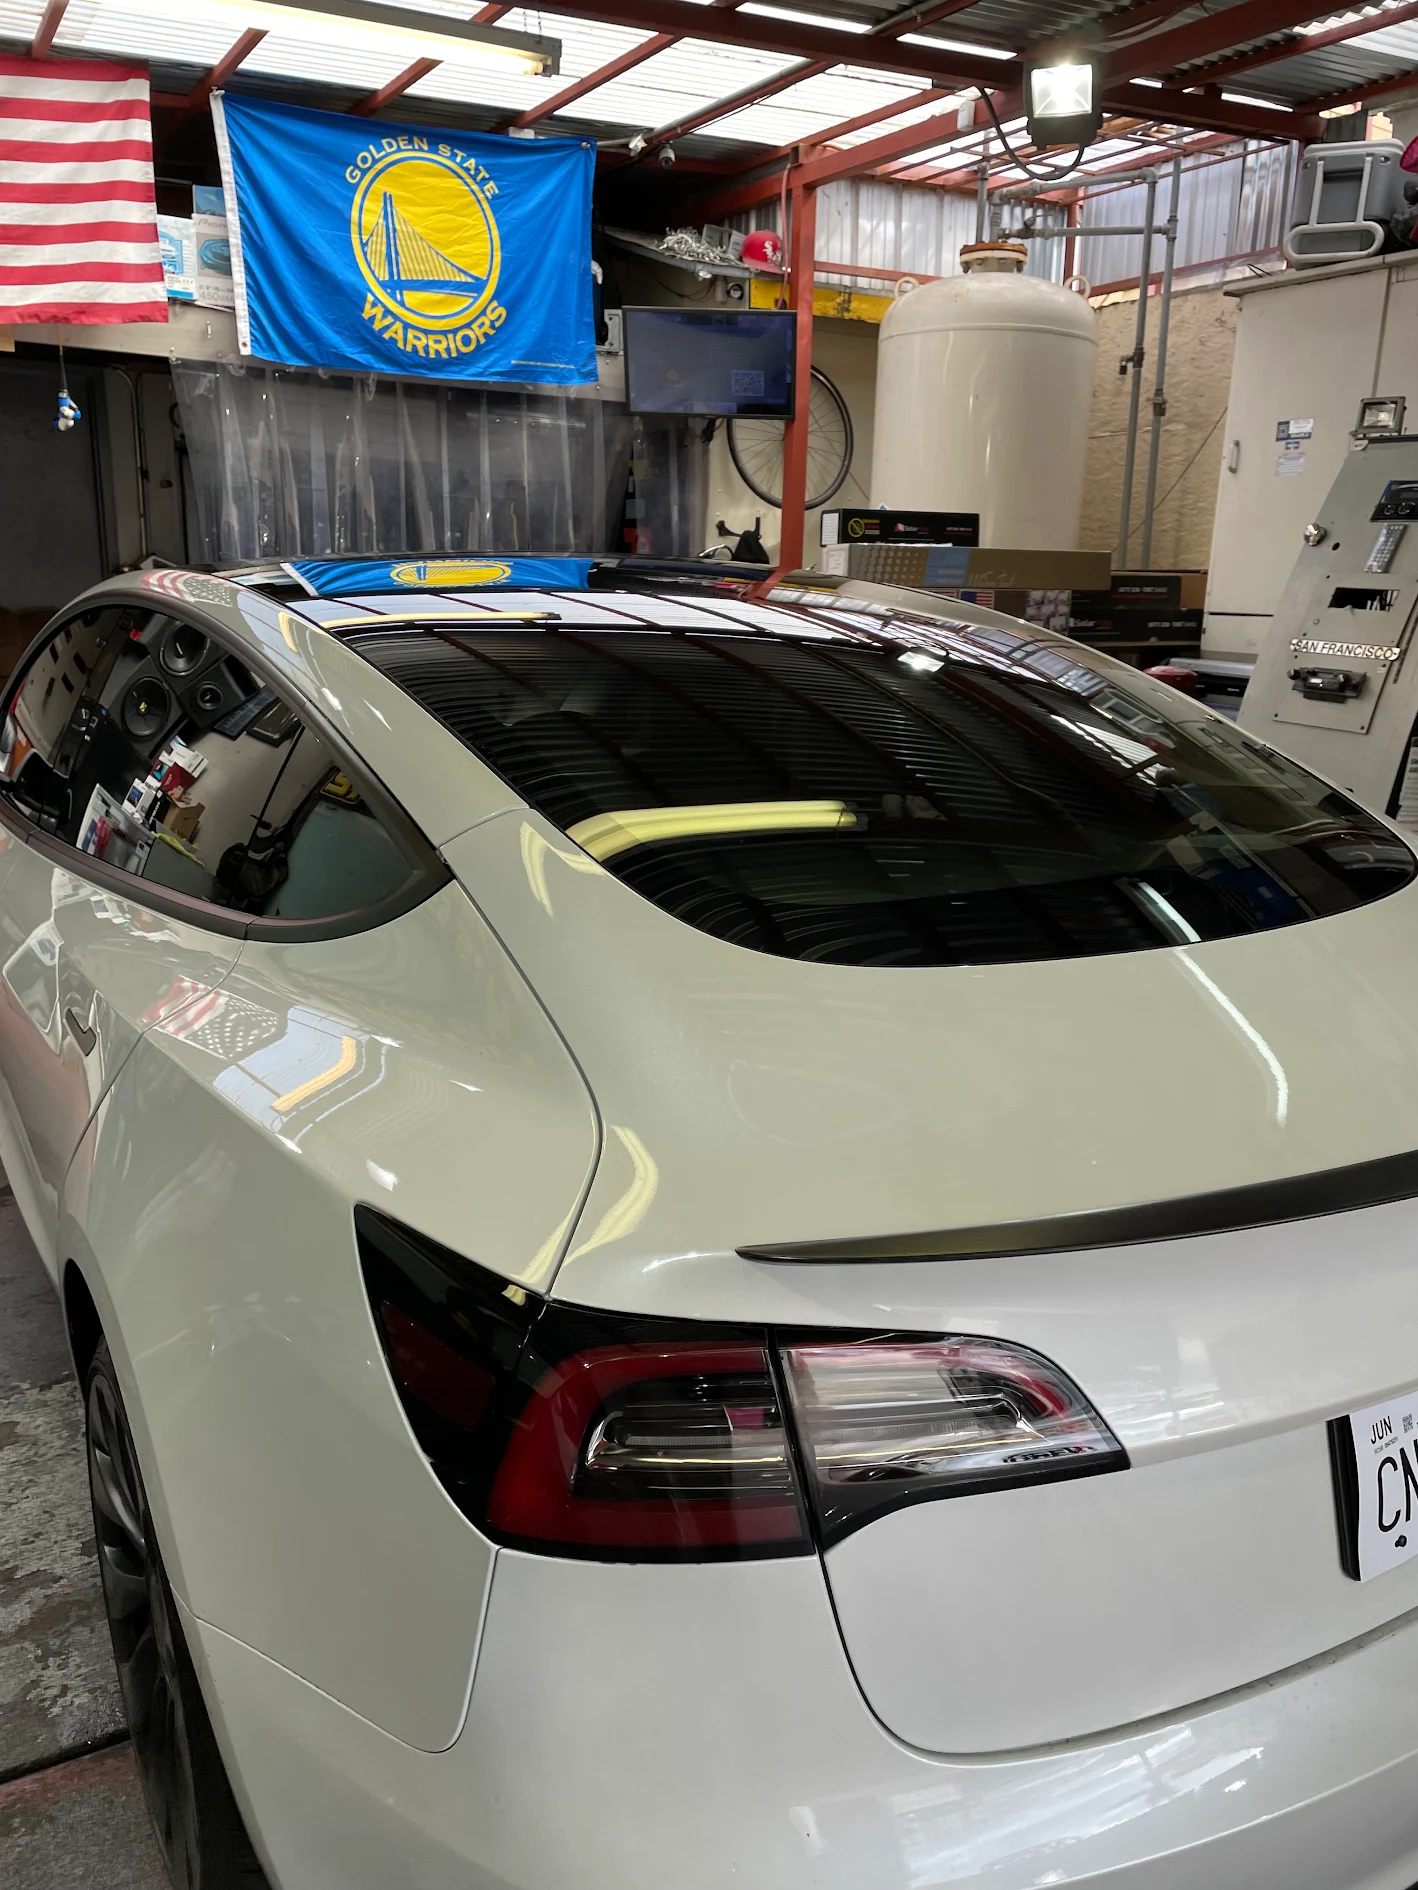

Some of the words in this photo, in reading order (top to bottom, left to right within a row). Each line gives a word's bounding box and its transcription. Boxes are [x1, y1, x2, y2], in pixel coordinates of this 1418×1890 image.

[344, 135, 429, 185] GOLDEN
[437, 143, 500, 200] STATE
[361, 292, 508, 359] WARRIORS
[1295, 640, 1319, 653] SAN
[1320, 642, 1394, 660] FRANCISCO
[1370, 1415, 1393, 1445] JUN
